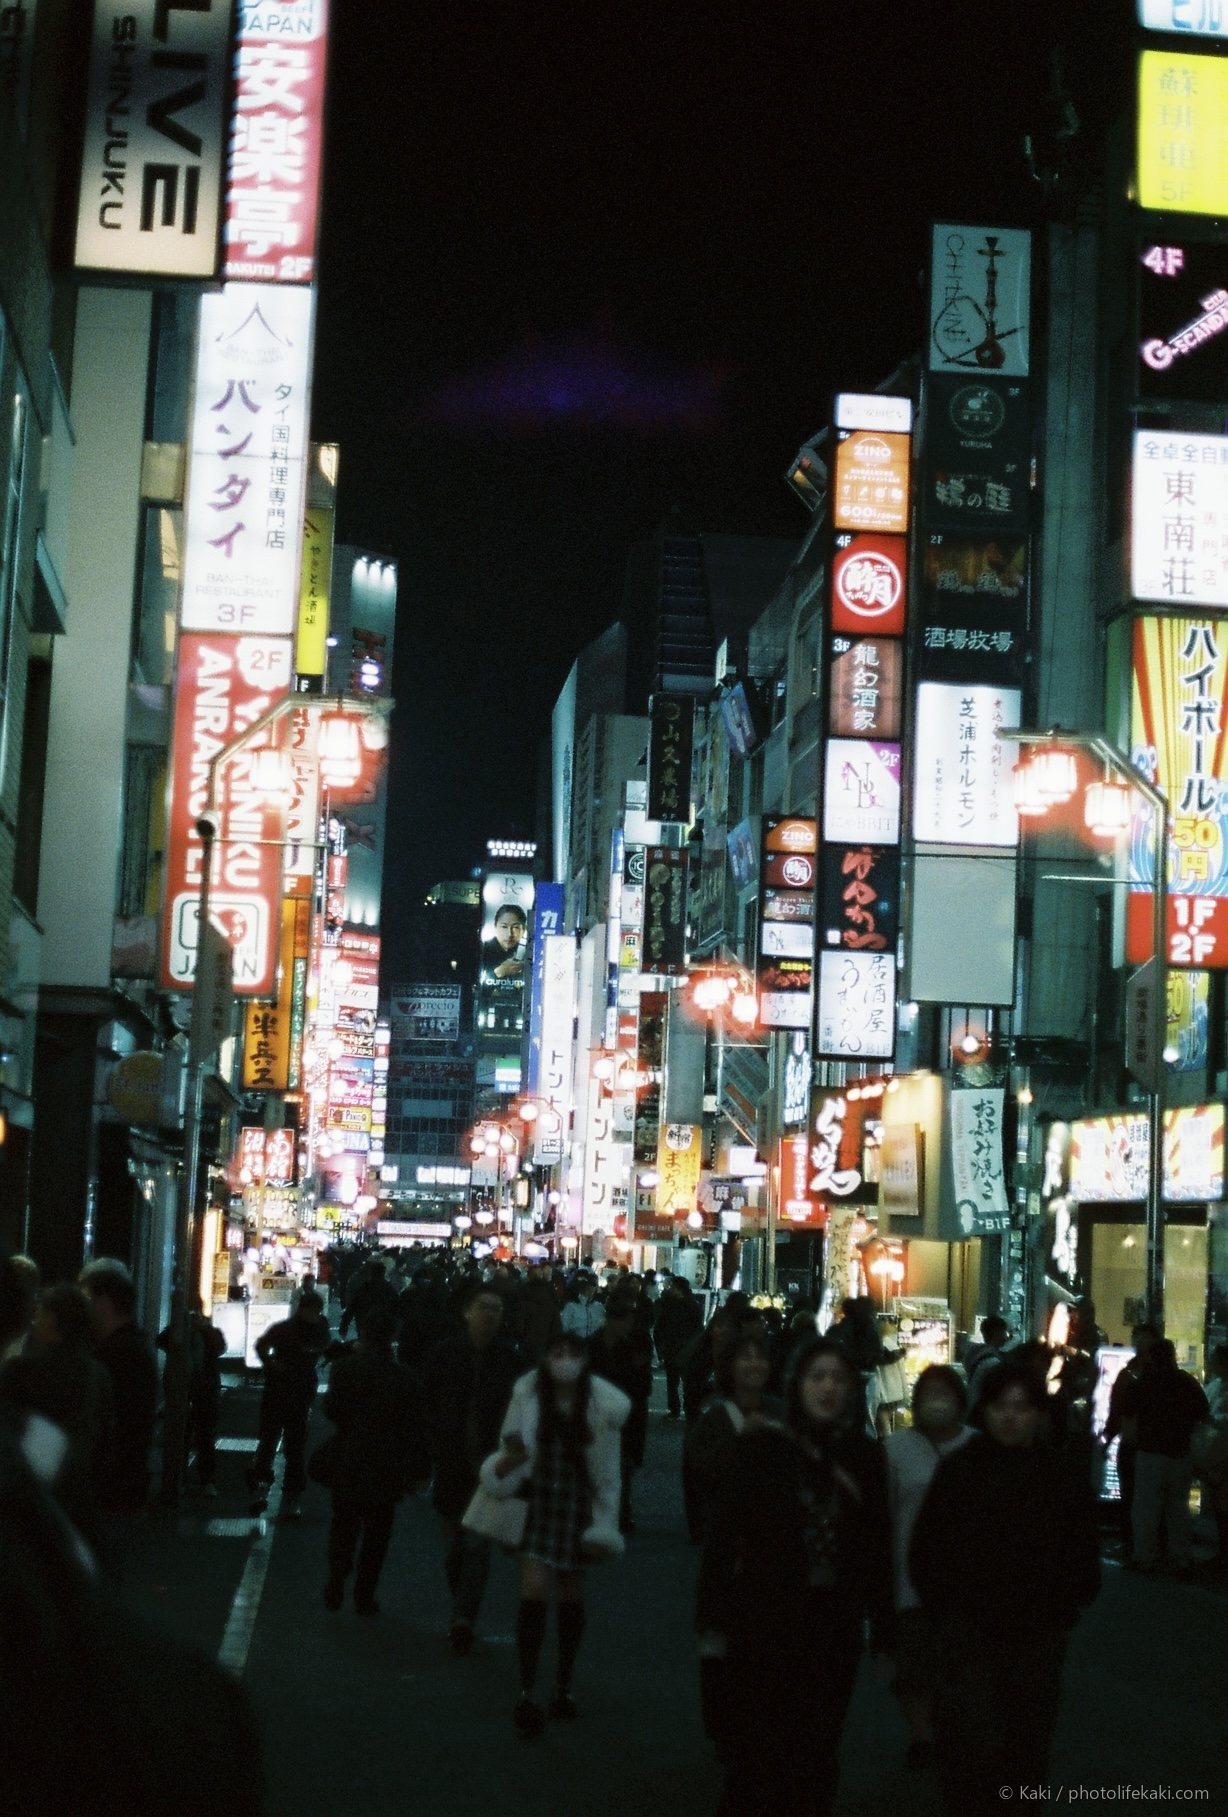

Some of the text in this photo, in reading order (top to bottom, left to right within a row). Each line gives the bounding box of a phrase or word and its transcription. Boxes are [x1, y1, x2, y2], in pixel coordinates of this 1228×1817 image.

[99, 14, 137, 231] SHINJUKU
[227, 43, 311, 257] 安楽亭
[279, 256, 314, 279] 2F
[1142, 245, 1185, 276] 4F
[209, 378, 262, 559] バンタイ
[264, 383, 293, 551] タイ国料理専門店
[836, 535, 851, 547] 4F
[930, 535, 944, 545] 2F
[1161, 469, 1197, 596] 東南荘
[195, 584, 283, 599] RESTAURANT
[217, 603, 257, 625] 3F
[834, 639, 851, 652] 3F
[924, 626, 1014, 653] 酒場牧場
[250, 650, 285, 673] 2F
[1179, 626, 1219, 811] ハイボール
[879, 749, 900, 767] 2F
[958, 696, 977, 829] 芝浦ホルモン
[984, 1217, 1011, 1231] B1F
